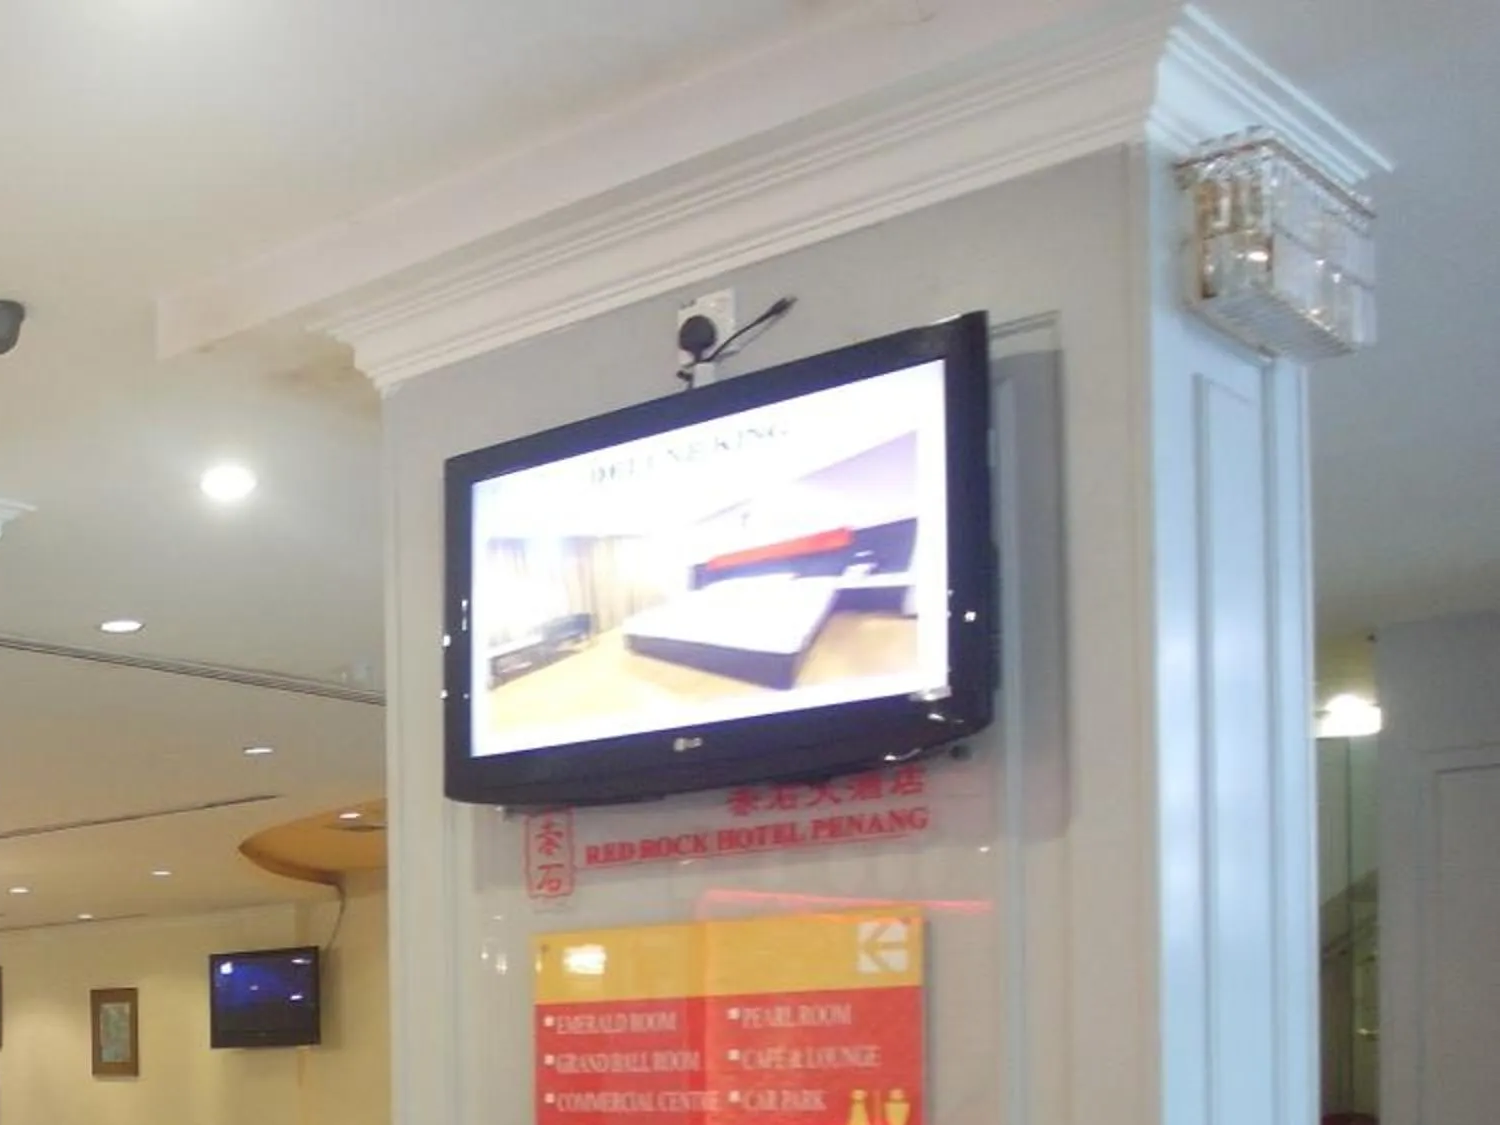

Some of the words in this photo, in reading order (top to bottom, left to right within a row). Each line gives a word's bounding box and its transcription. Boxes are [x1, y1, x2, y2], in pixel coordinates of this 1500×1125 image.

[585, 842, 635, 865] RED
[639, 835, 708, 859] ROCK
[717, 822, 804, 850] HOTEL
[811, 807, 929, 839] PENANG
[556, 1014, 628, 1034] EMERALD
[630, 1012, 677, 1032] ROOM
[798, 1004, 852, 1026] ROOM
[556, 1053, 609, 1073] GRAND
[652, 1050, 700, 1072] ROOM
[804, 1045, 881, 1069] LOUNGE
[556, 1092, 655, 1112] COMMERCIAL
[780, 1089, 828, 1112] PARK
